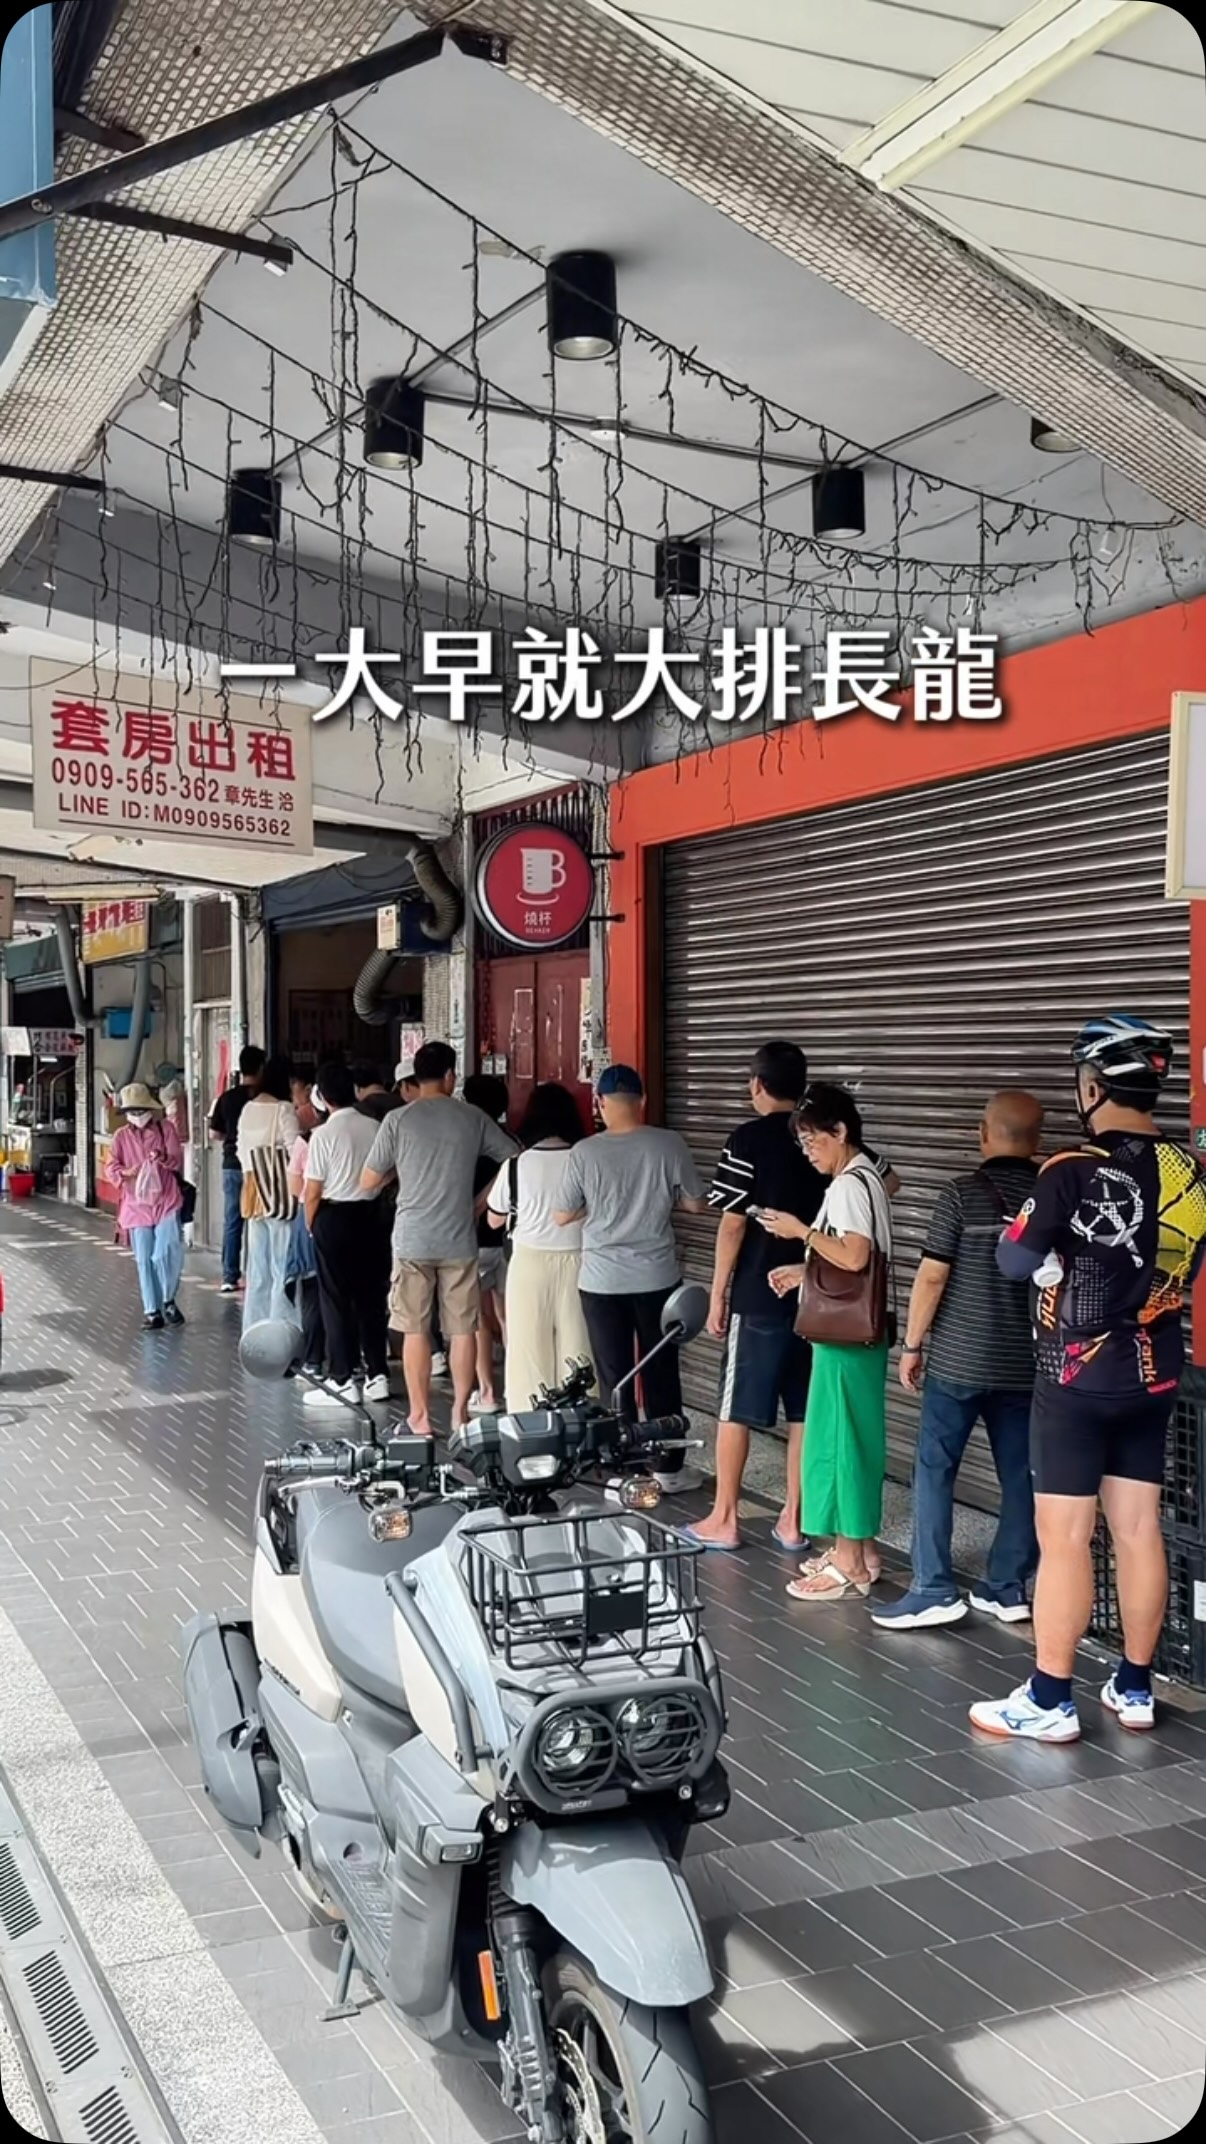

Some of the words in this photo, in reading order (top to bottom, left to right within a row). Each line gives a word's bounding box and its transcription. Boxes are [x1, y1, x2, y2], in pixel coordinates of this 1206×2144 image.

[51, 700, 296, 782] 套房出租
[52, 757, 219, 804] 0909-565-362
[59, 792, 109, 816] LINE
